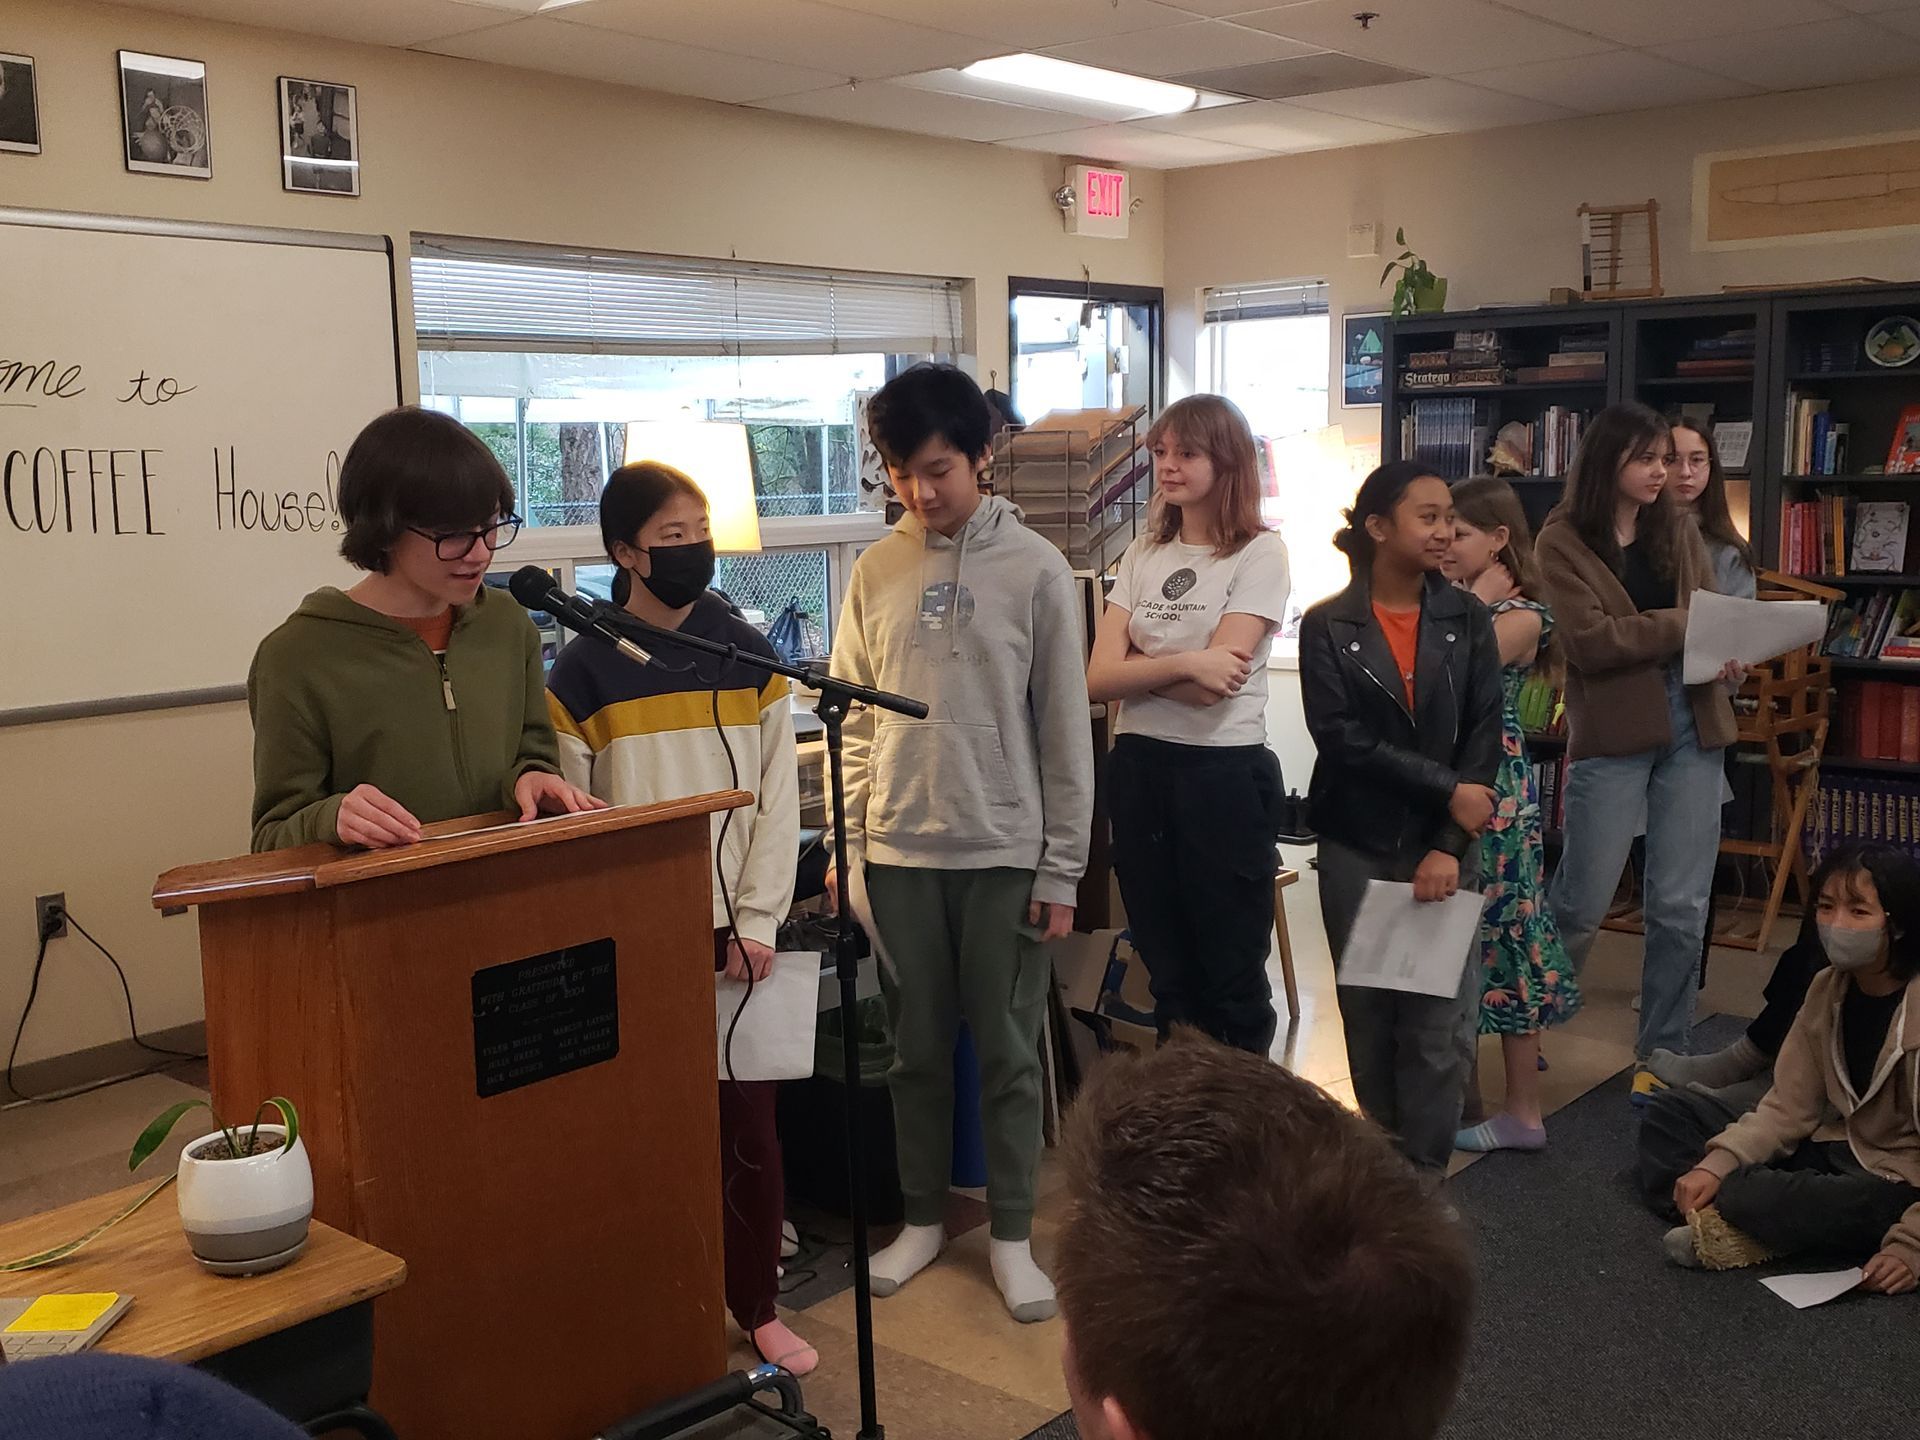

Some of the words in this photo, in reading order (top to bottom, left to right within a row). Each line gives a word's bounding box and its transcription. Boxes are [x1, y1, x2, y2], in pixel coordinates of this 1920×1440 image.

[1087, 171, 1123, 217] EXIT
[116, 369, 198, 406] to
[1405, 372, 1450, 386] Stratego
[3, 446, 166, 536] COFFEE
[213, 445, 341, 532] House!
[1137, 599, 1165, 611] CADE
[1144, 611, 1183, 622] SCHOOL
[518, 958, 576, 981] PRESENTED
[480, 992, 505, 1005] WITH
[572, 970, 585, 981] BY
[591, 963, 610, 977] THE
[545, 992, 558, 1003] OF
